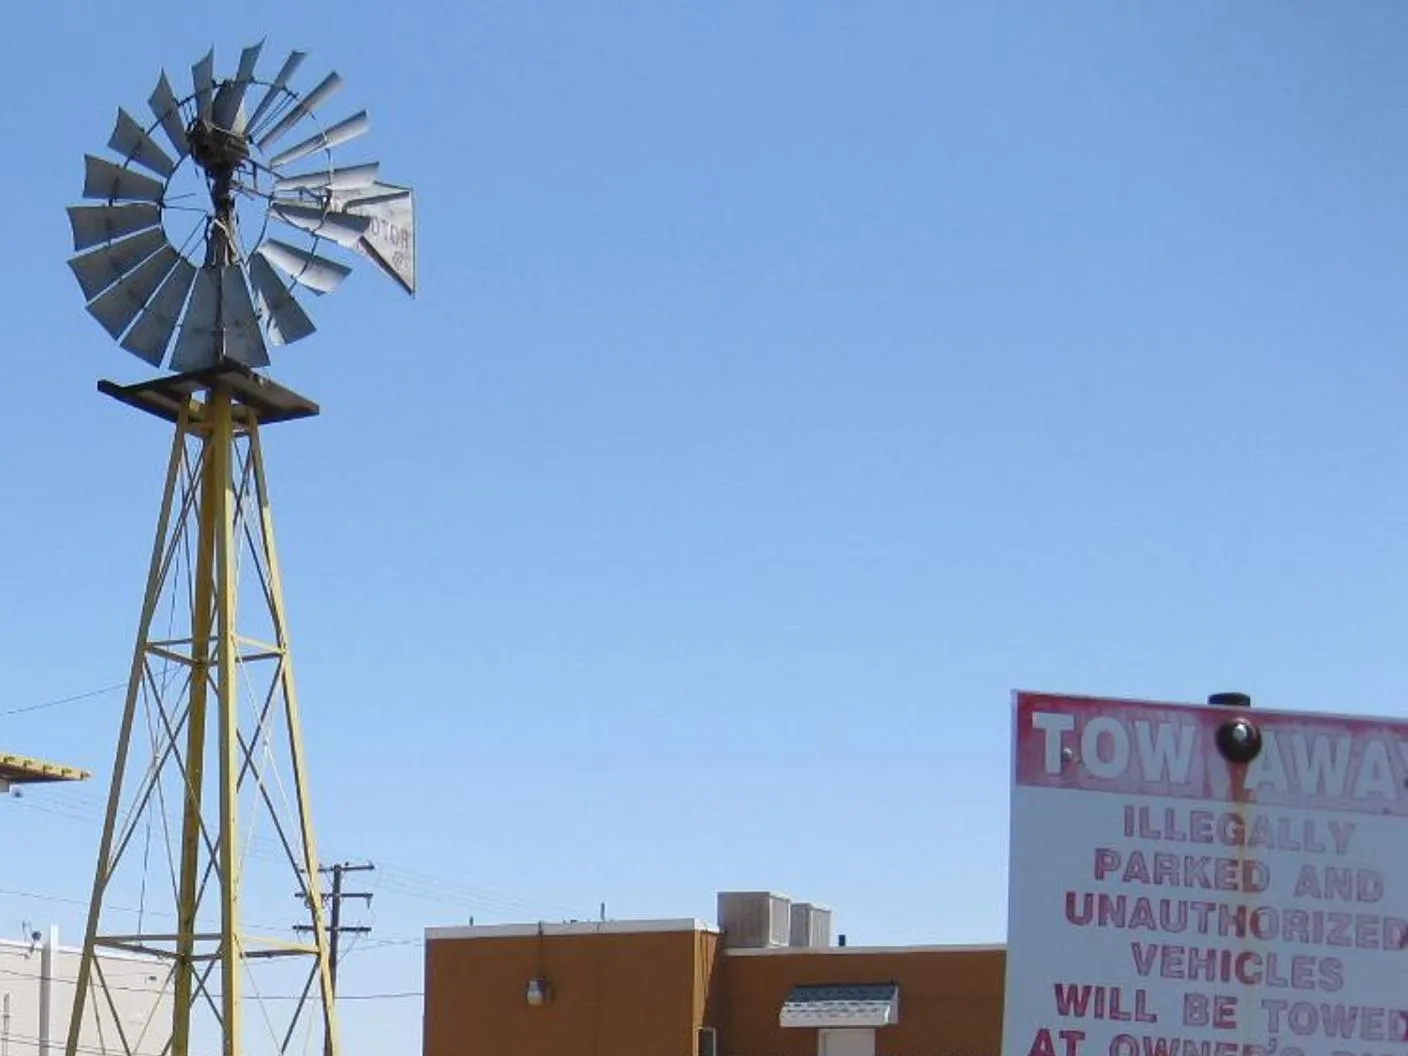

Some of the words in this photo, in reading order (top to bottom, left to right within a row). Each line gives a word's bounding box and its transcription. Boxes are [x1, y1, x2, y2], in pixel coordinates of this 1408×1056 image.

[1032, 711, 1196, 784] TOW
[1244, 728, 1408, 801] AWA
[1123, 804, 1356, 856] ILLEGALLY
[1094, 848, 1270, 894] PARKED
[1294, 864, 1384, 903] AND
[1064, 892, 1408, 952] UNAUTHORIZED
[1131, 942, 1345, 992] VEHICLES
[1054, 983, 1158, 1023] WILL
[1182, 993, 1238, 1030] BE
